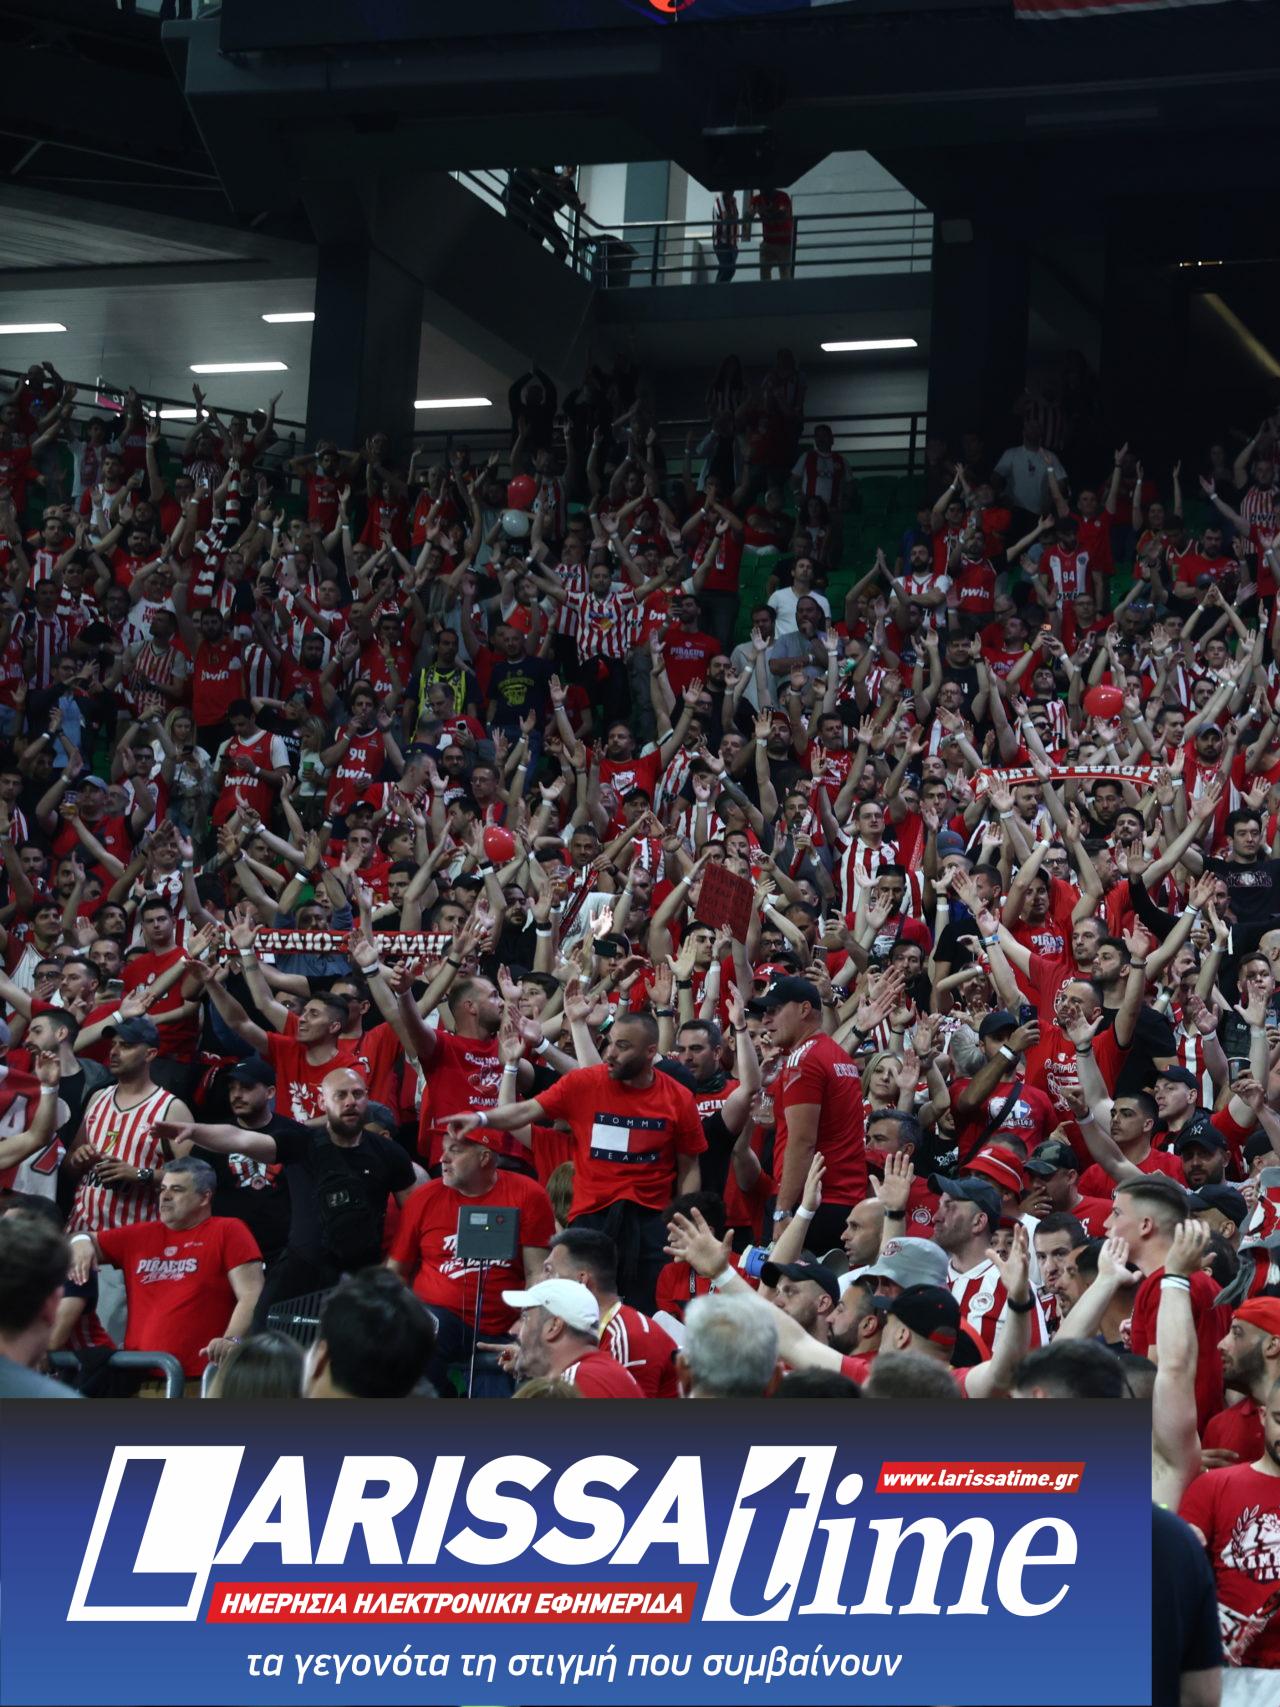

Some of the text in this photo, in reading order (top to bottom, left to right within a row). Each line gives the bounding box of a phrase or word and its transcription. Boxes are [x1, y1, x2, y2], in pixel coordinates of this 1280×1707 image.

[201, 668, 230, 683] bwin
[349, 747, 367, 762] 94
[225, 771, 261, 787] bwin
[599, 1115, 665, 1129] TOMMY
[593, 1148, 657, 1162] JEANS
[136, 1257, 198, 1274] PIRAEUS
